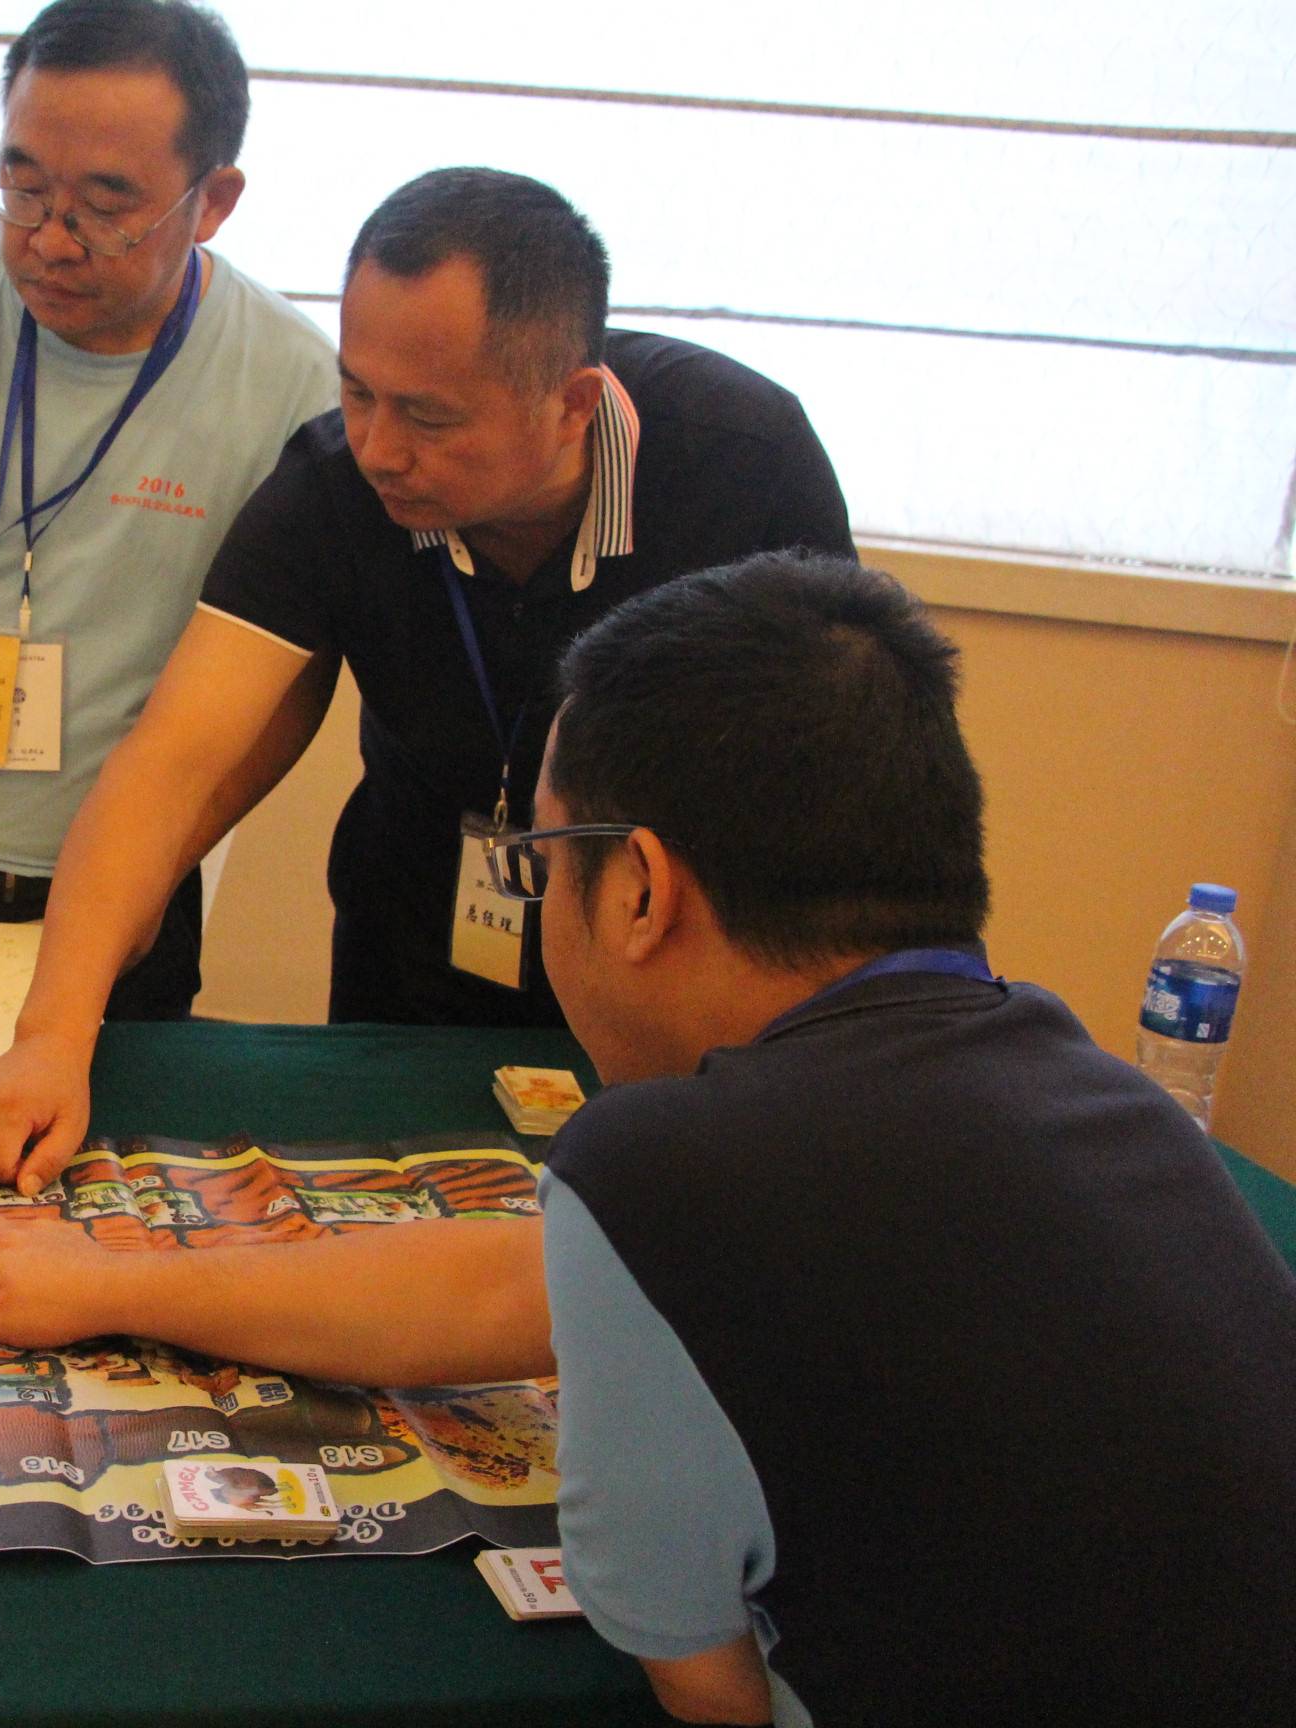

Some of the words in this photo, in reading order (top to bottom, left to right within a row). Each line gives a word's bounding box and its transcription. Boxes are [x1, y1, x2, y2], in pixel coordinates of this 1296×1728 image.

[136, 475, 186, 499] 2016
[170, 1431, 227, 1449] S17
[322, 1447, 380, 1466] S18
[24, 1457, 84, 1481] S16
